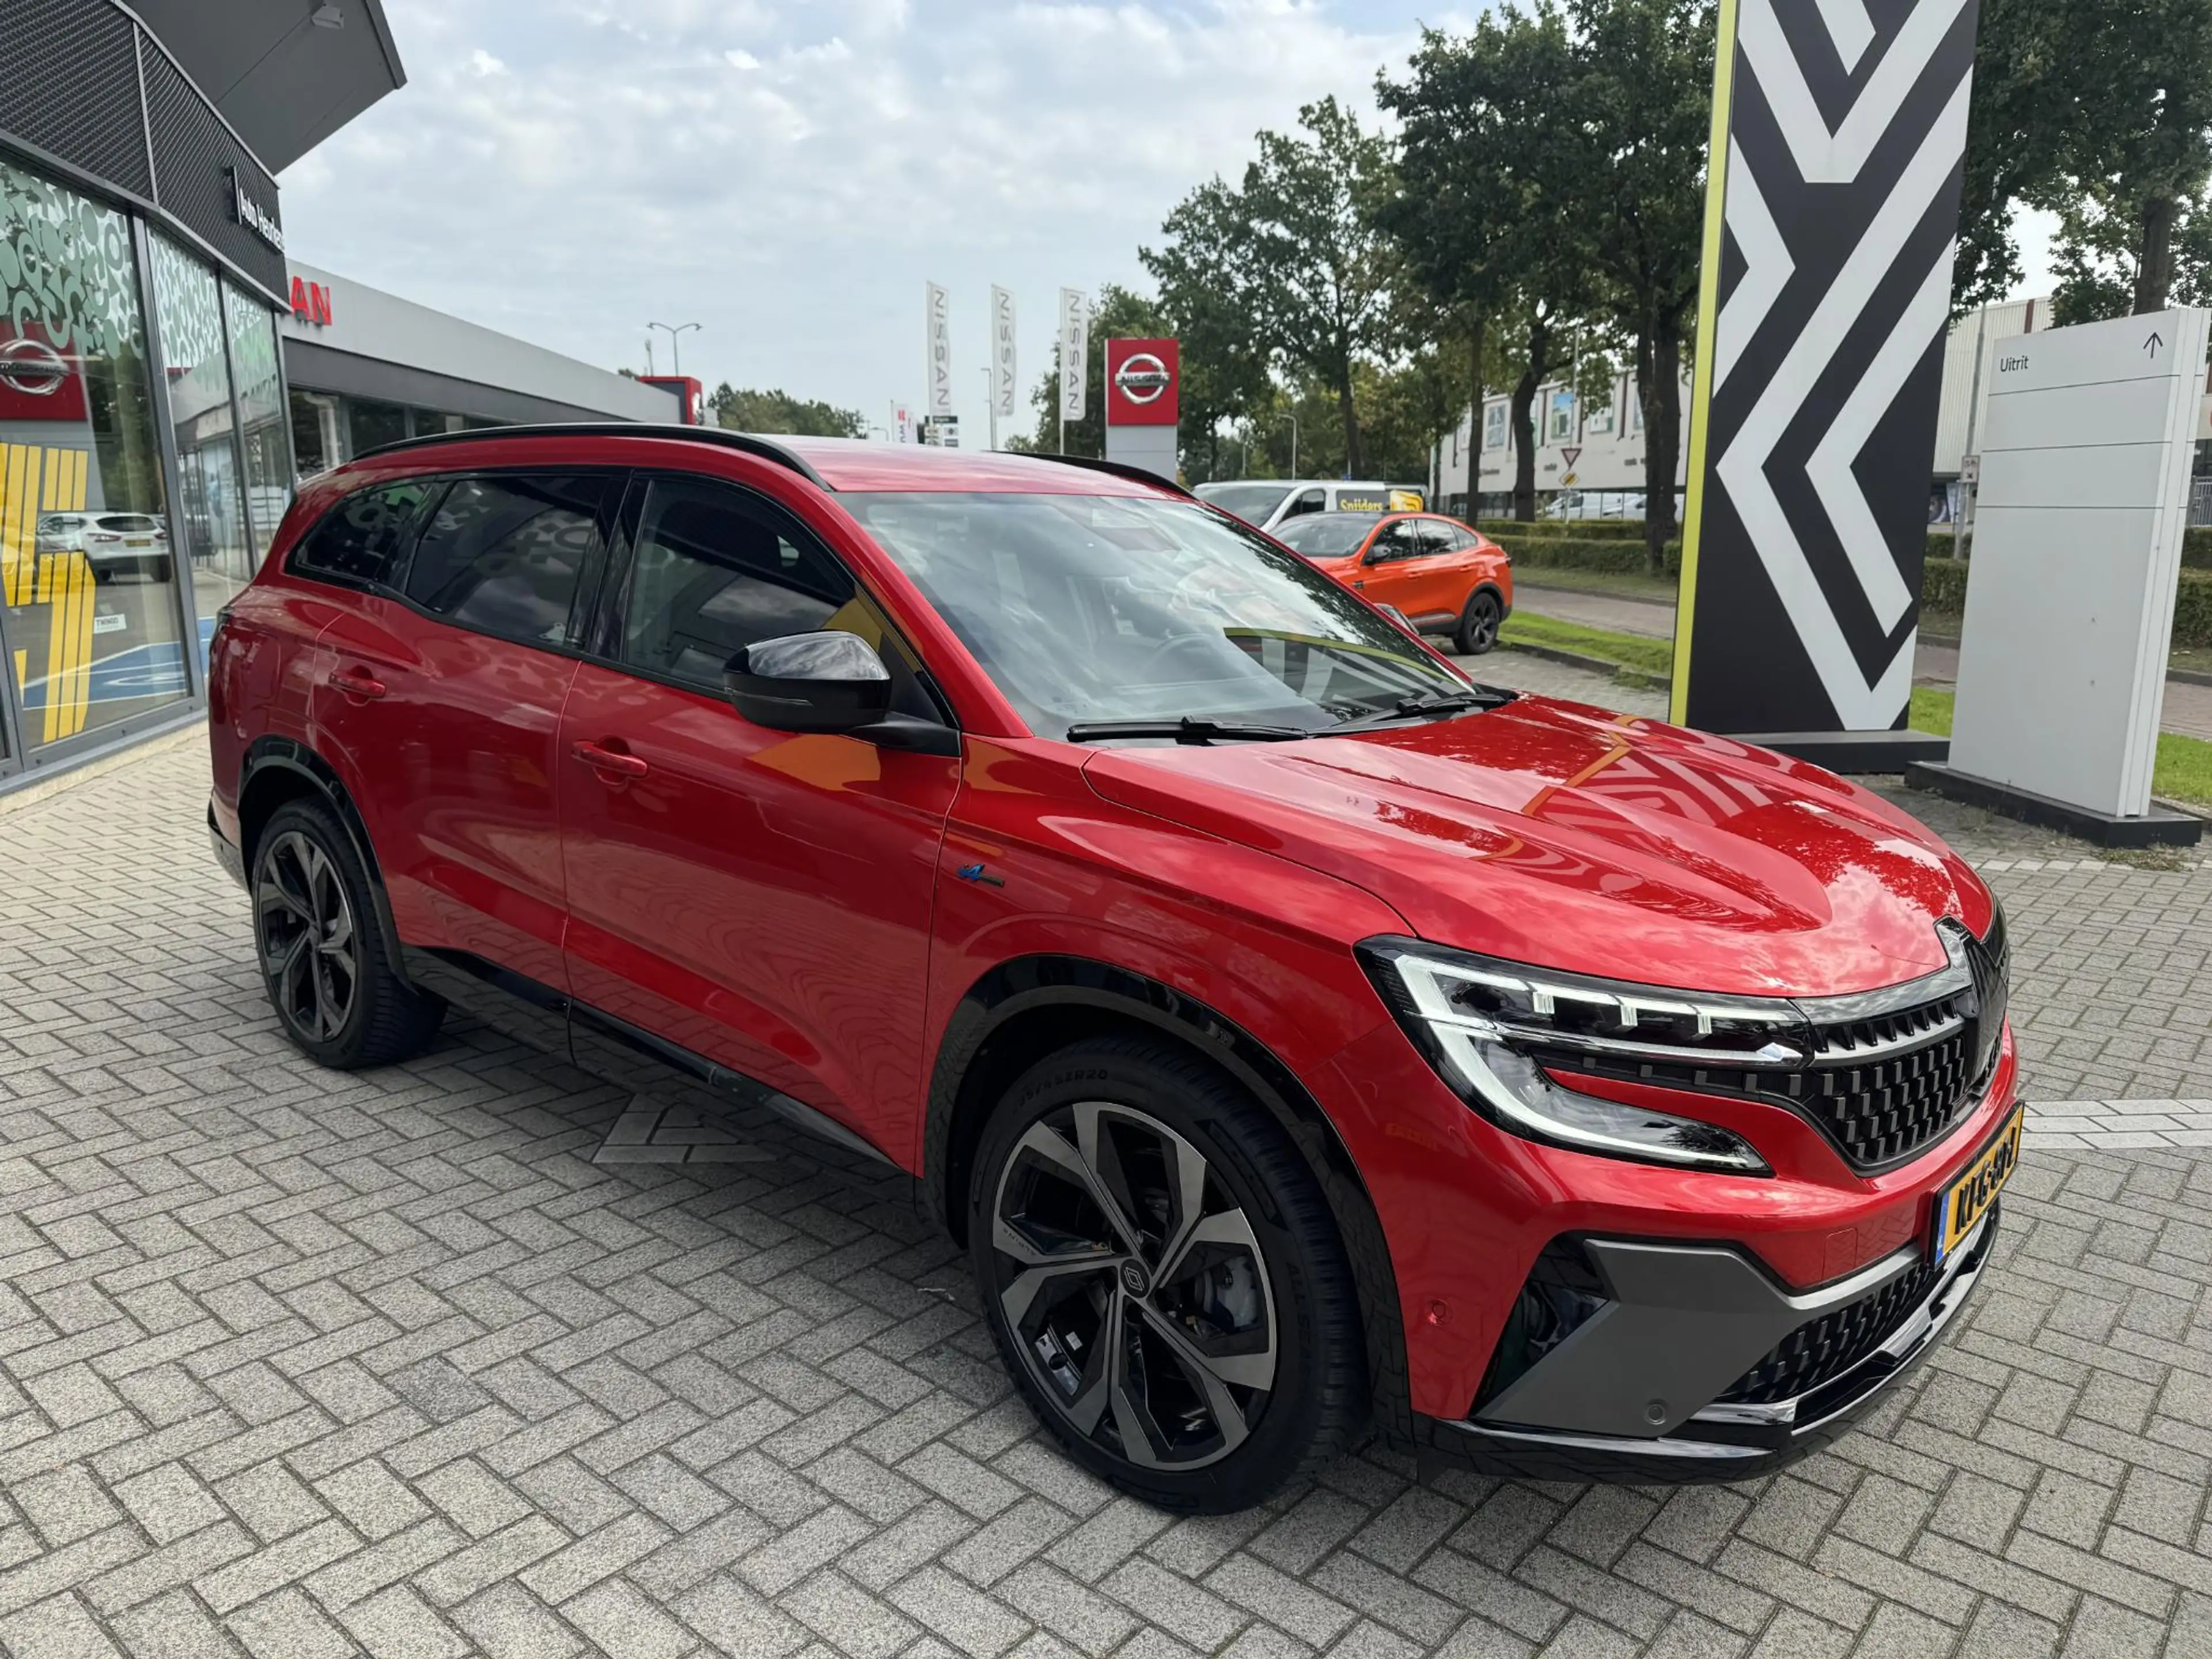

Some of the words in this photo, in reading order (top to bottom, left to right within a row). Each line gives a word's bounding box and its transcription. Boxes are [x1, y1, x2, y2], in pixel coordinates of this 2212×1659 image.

[934, 290, 949, 406] NISSAN
[999, 293, 1012, 408] NISSAN
[1068, 294, 1081, 410] NISSAN
[2000, 355, 2029, 372] Uitrit
